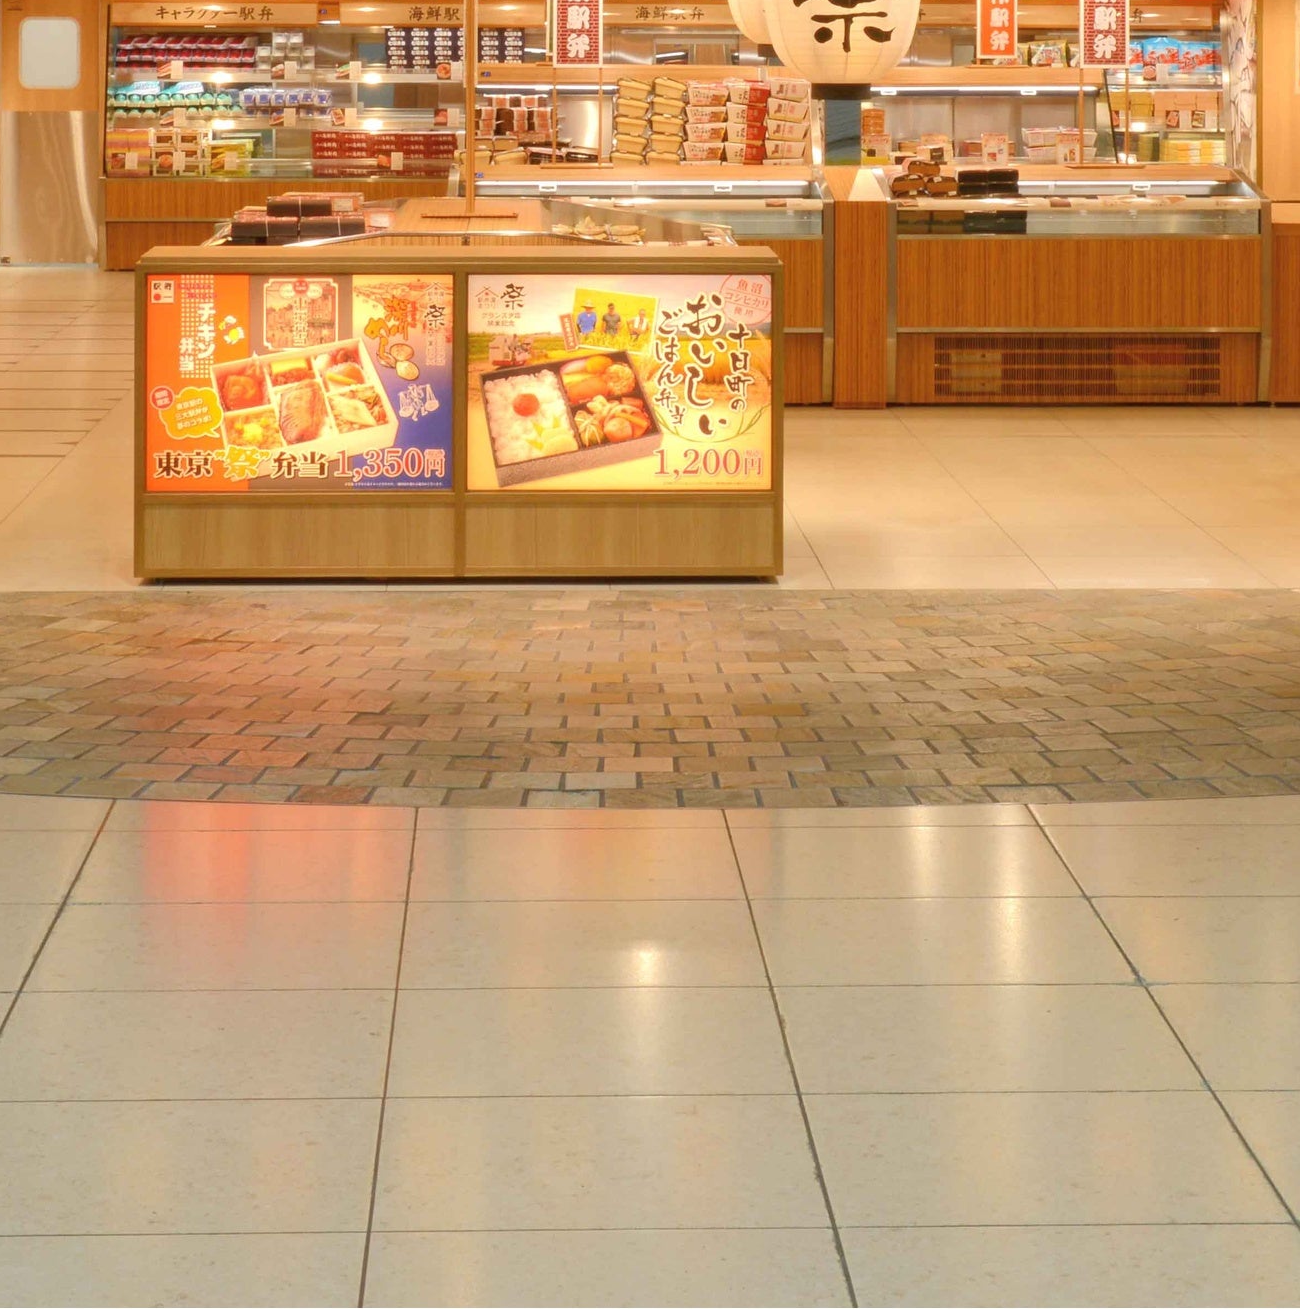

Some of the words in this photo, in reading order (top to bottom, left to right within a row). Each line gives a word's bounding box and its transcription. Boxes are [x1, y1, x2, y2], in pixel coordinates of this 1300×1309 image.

[155, 5, 274, 21] キャラクター駅弁
[500, 282, 527, 310] 祭
[724, 291, 769, 309] コシヒカリ
[736, 278, 764, 294] 魚沼
[196, 302, 217, 359] チキン
[424, 303, 446, 328] 祭
[178, 336, 196, 372] 弁当
[654, 308, 686, 425] ごはん弁当
[681, 294, 728, 436] おいしい
[727, 323, 754, 411] 十日町の
[333, 447, 446, 482] 1,350円
[654, 448, 762, 480] 1,200円
